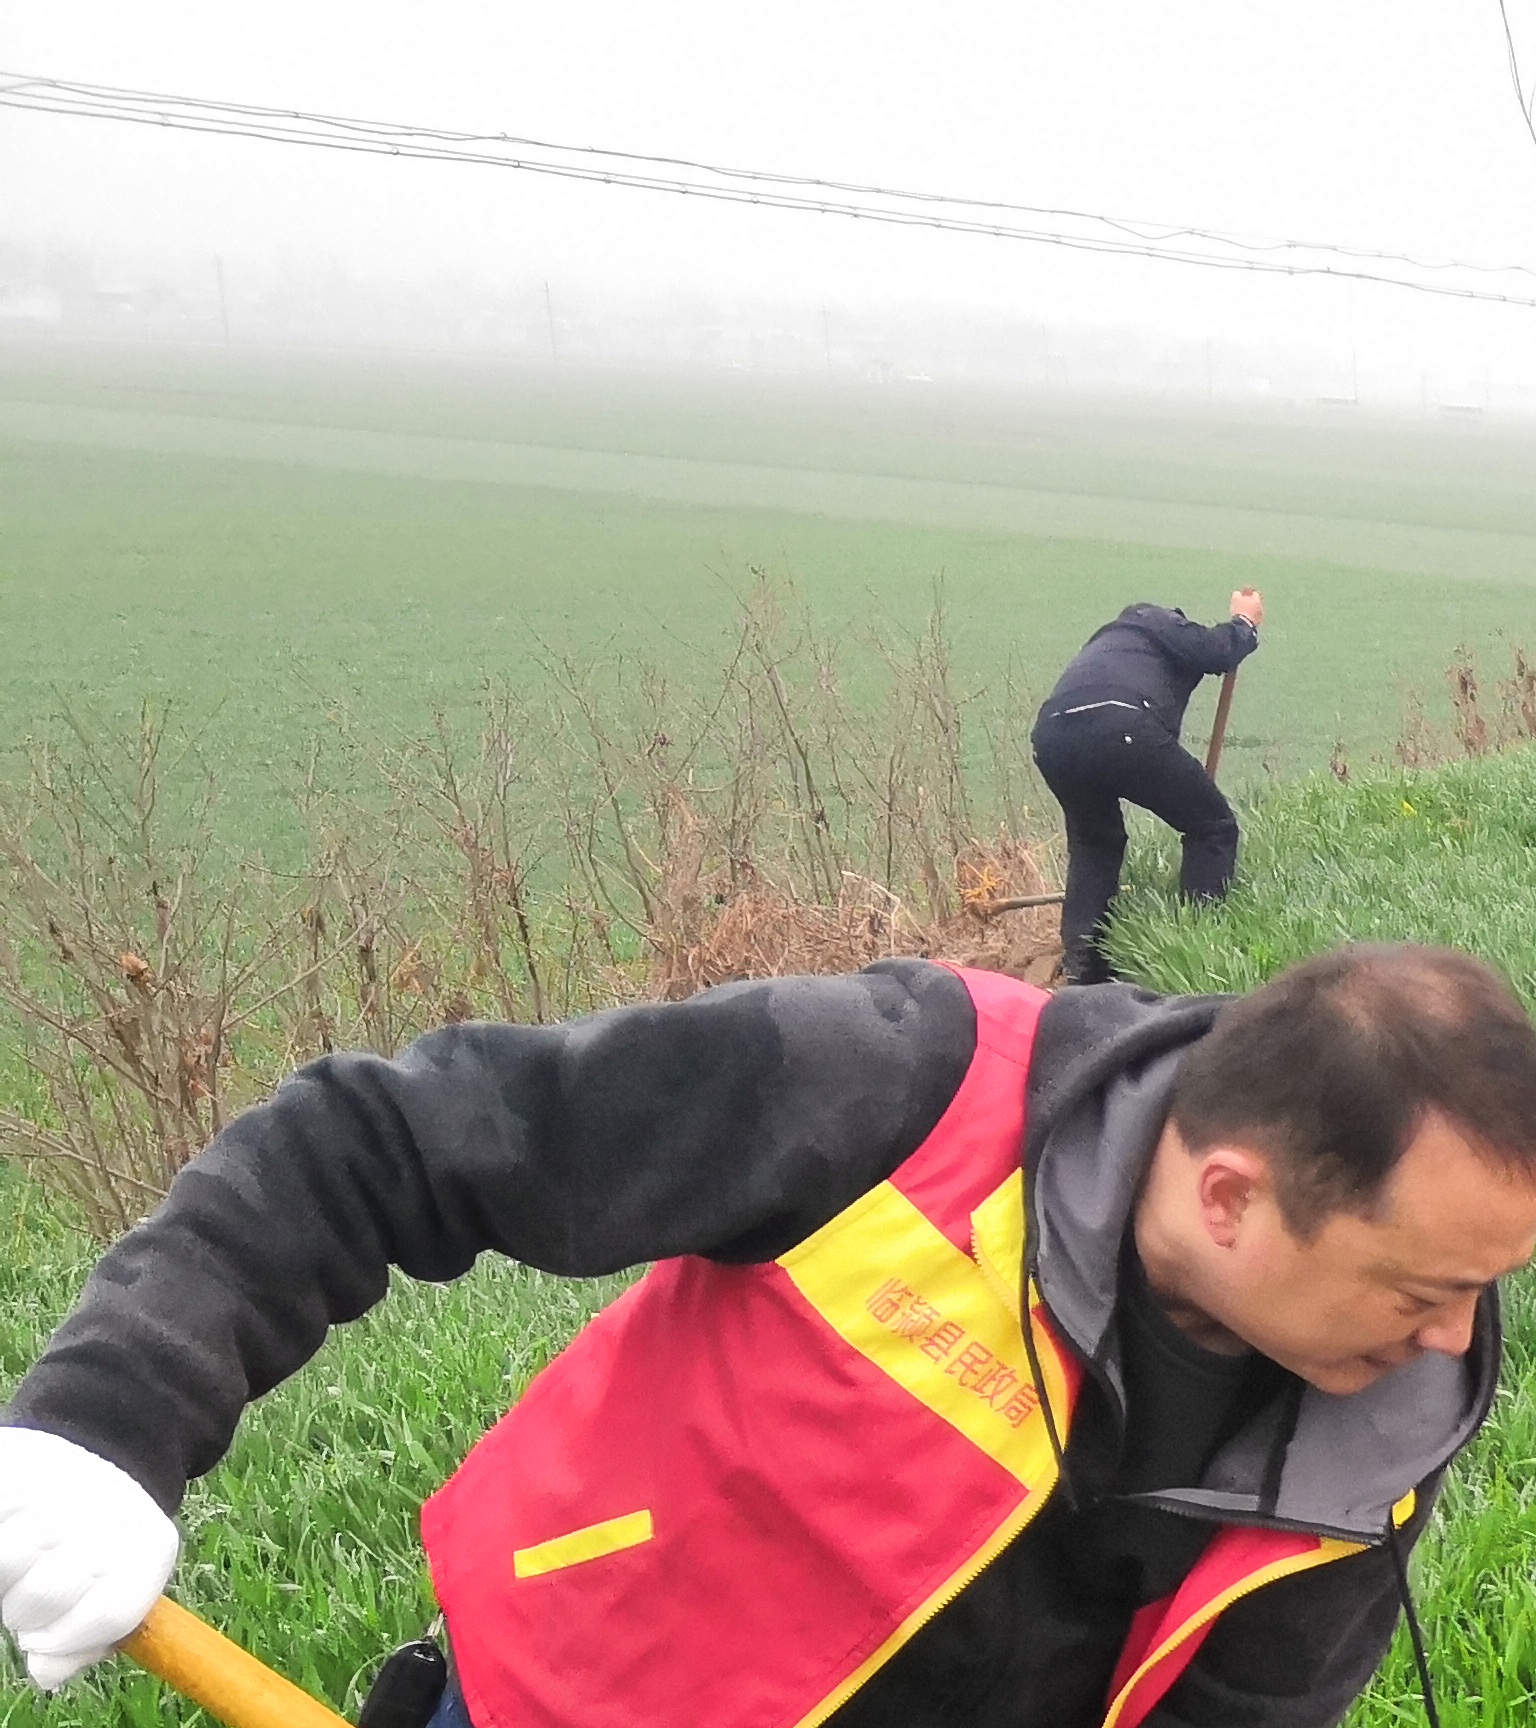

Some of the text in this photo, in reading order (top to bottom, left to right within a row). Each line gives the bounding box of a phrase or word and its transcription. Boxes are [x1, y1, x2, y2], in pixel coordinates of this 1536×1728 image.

[865, 1276, 1040, 1429] 临颍县民政局
